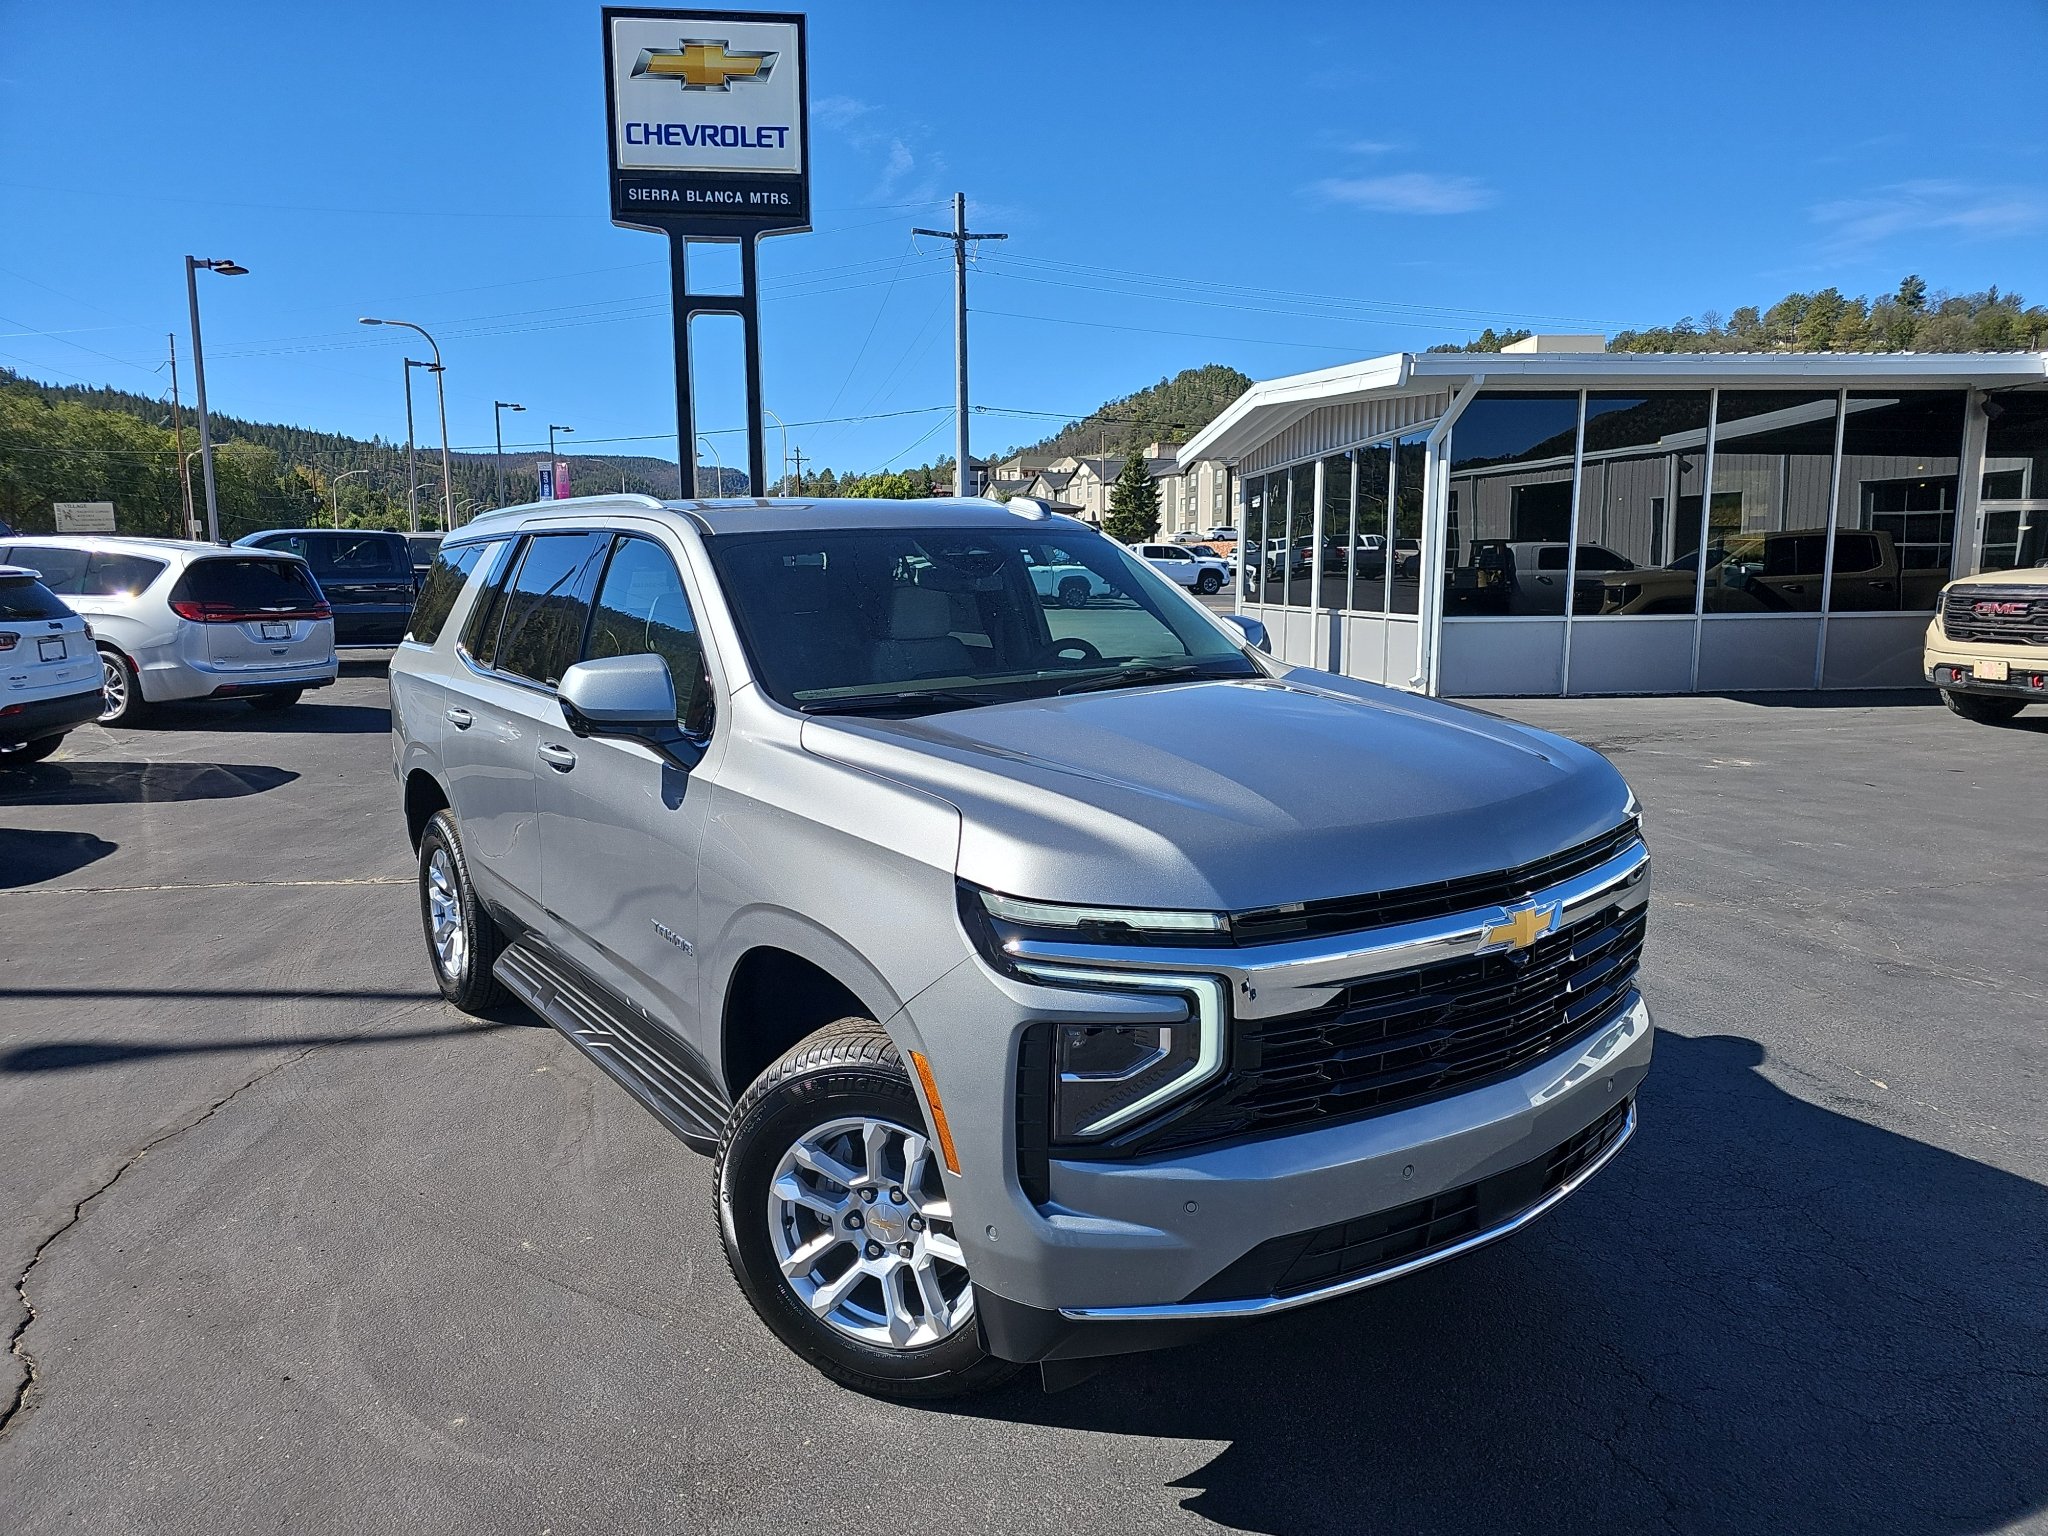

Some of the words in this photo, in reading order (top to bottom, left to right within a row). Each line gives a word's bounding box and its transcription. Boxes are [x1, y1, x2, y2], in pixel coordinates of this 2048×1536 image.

[625, 122, 790, 149] CHEVROLET
[628, 188, 680, 201] SIERRA
[686, 190, 743, 203] BLANCA
[749, 192, 792, 205] MTRS.
[1975, 602, 2029, 614] GMC
[650, 918, 694, 957] TAHOE
